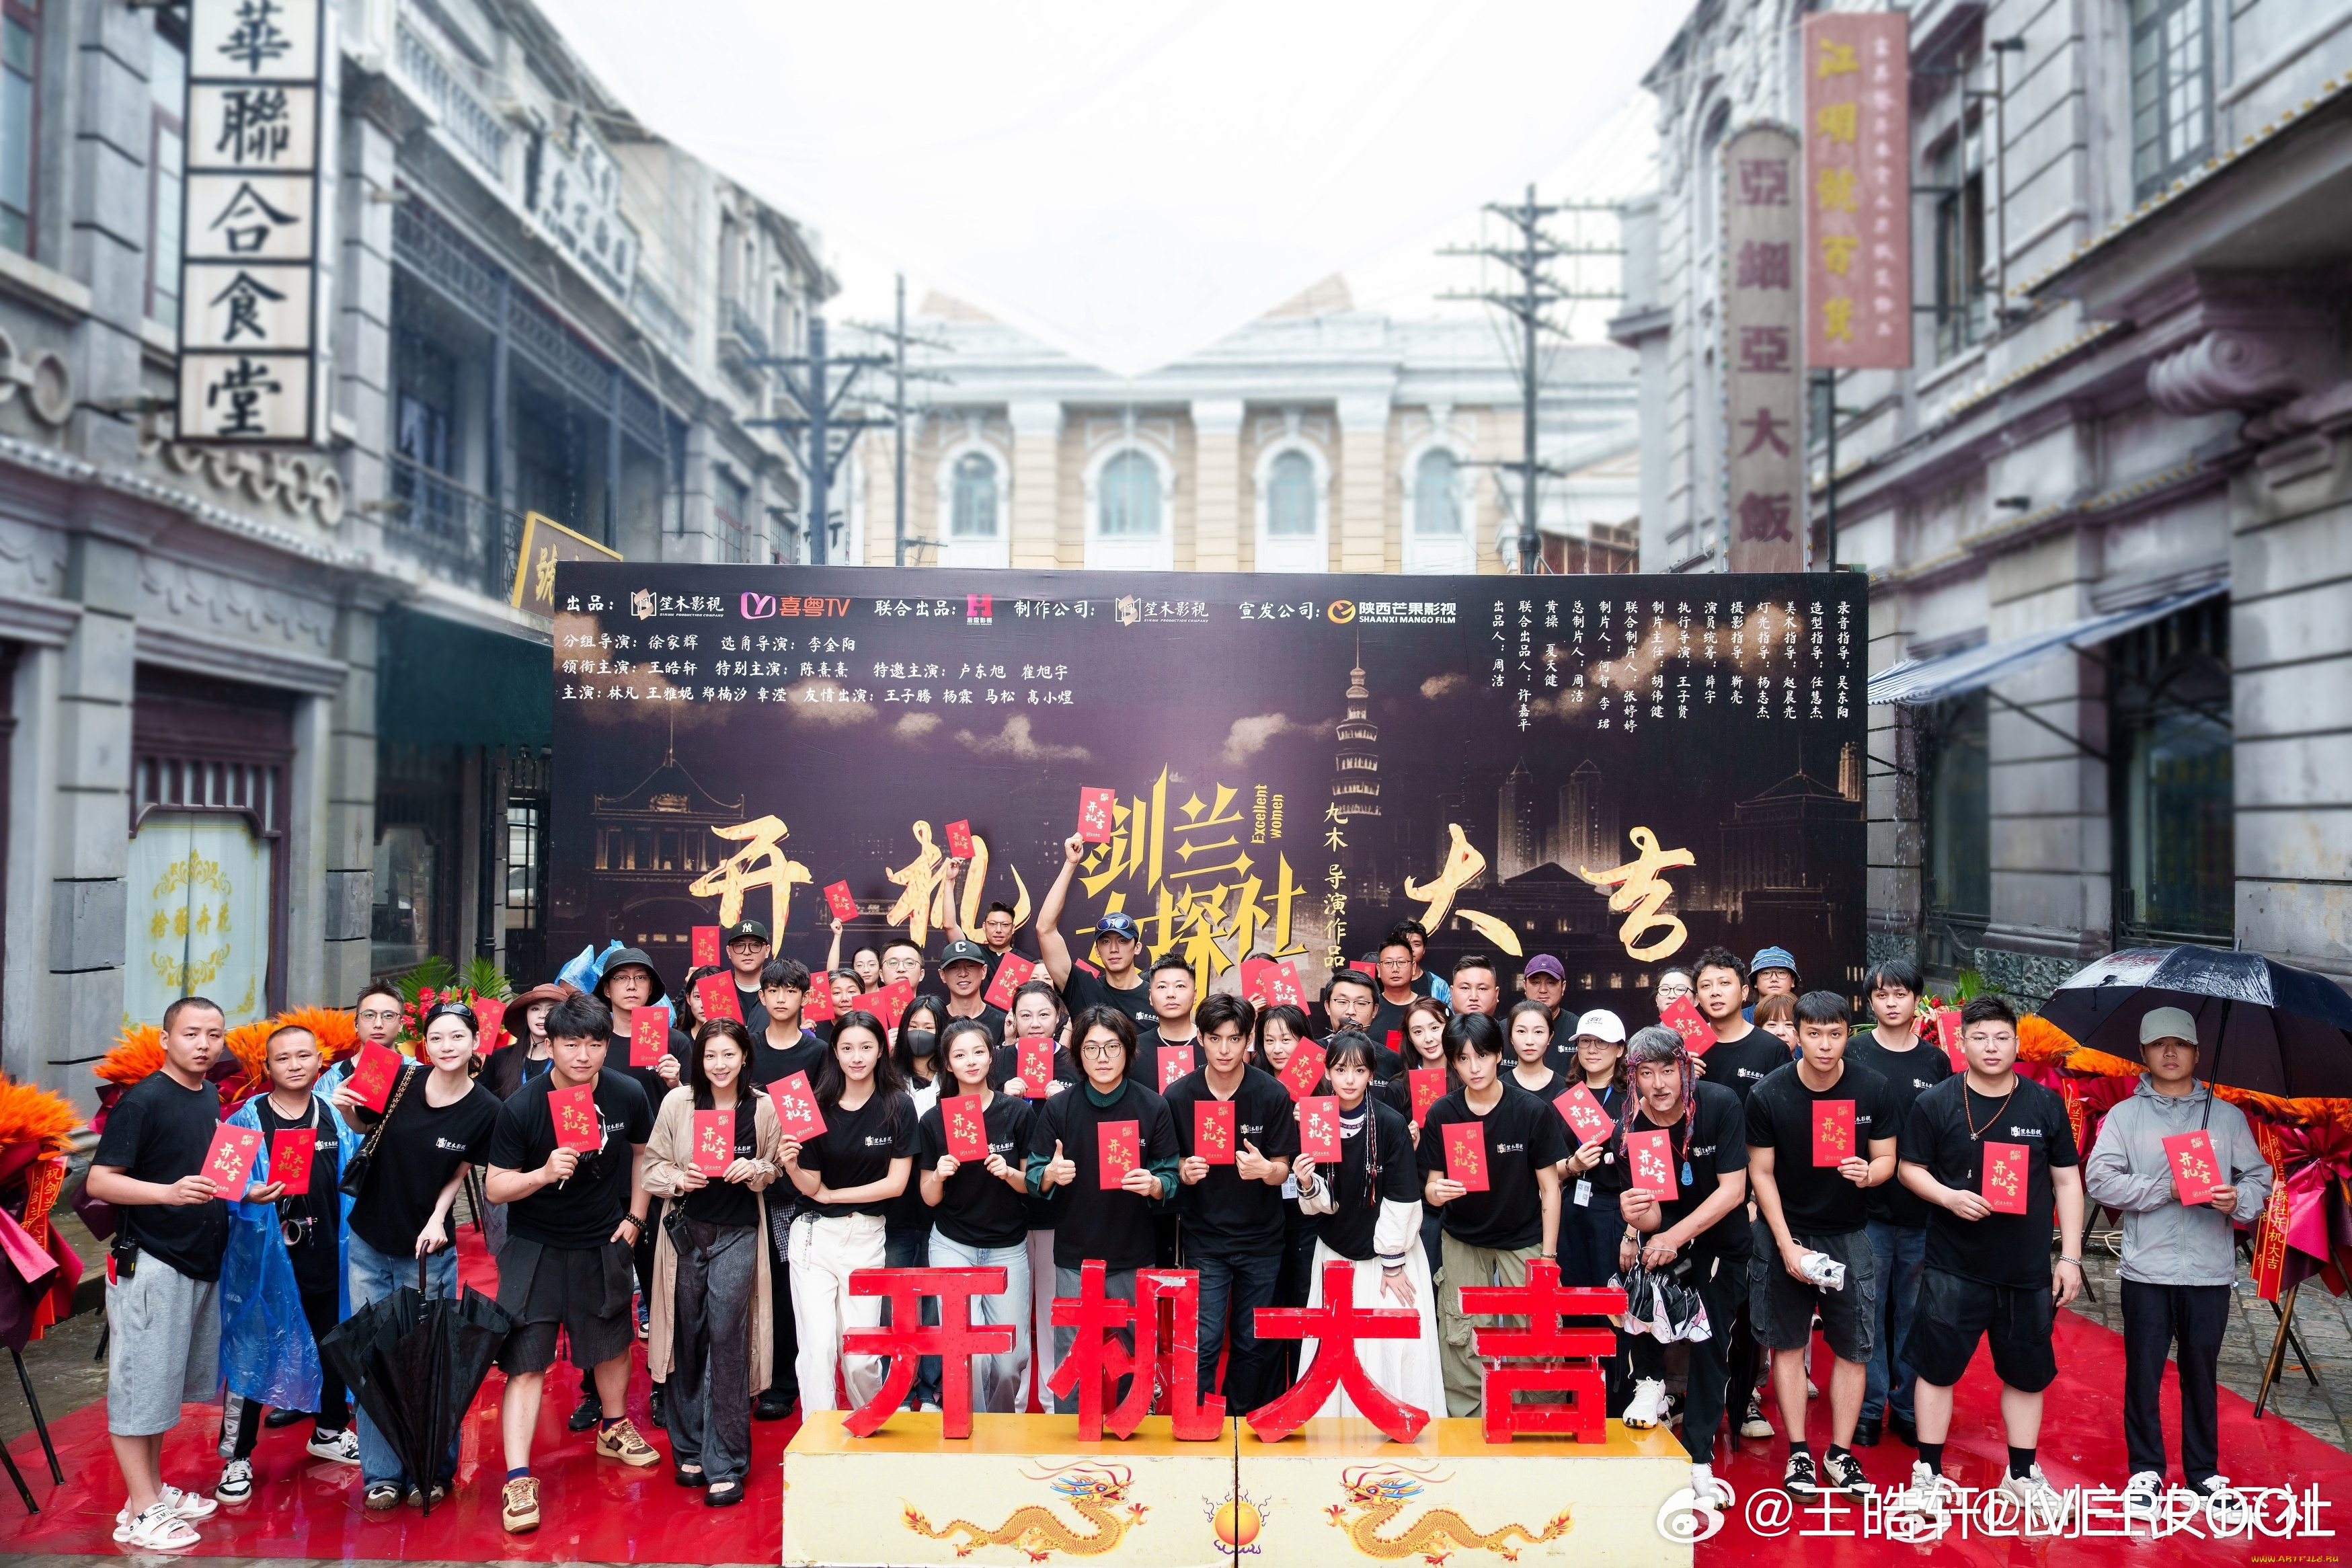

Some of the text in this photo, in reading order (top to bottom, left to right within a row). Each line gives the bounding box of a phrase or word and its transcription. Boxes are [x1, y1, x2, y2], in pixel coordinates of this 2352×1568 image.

[207, 0, 301, 436] 華聯合食堂
[660, 596, 724, 612] 笙木影視
[779, 596, 851, 617] 喜粤TV
[1144, 601, 1209, 618] 笙木影視
[1359, 602, 1456, 616] 陕西芒果影视
[1544, 600, 1559, 687] 黄操 夏天健
[1022, 664, 1068, 680] 崔旭宇
[646, 687, 694, 701] 王雅妮
[703, 687, 748, 703] 郑楠汐
[757, 687, 787, 703] 章滢
[943, 689, 973, 704] 杨霖
[985, 689, 1015, 704] 马松
[1251, 784, 1267, 844] Excellent
[1271, 794, 1285, 839] women
[1323, 801, 1348, 968] 九木 导演作品
[955, 941, 967, 954] C
[842, 1257, 1629, 1444] 开机大吉
